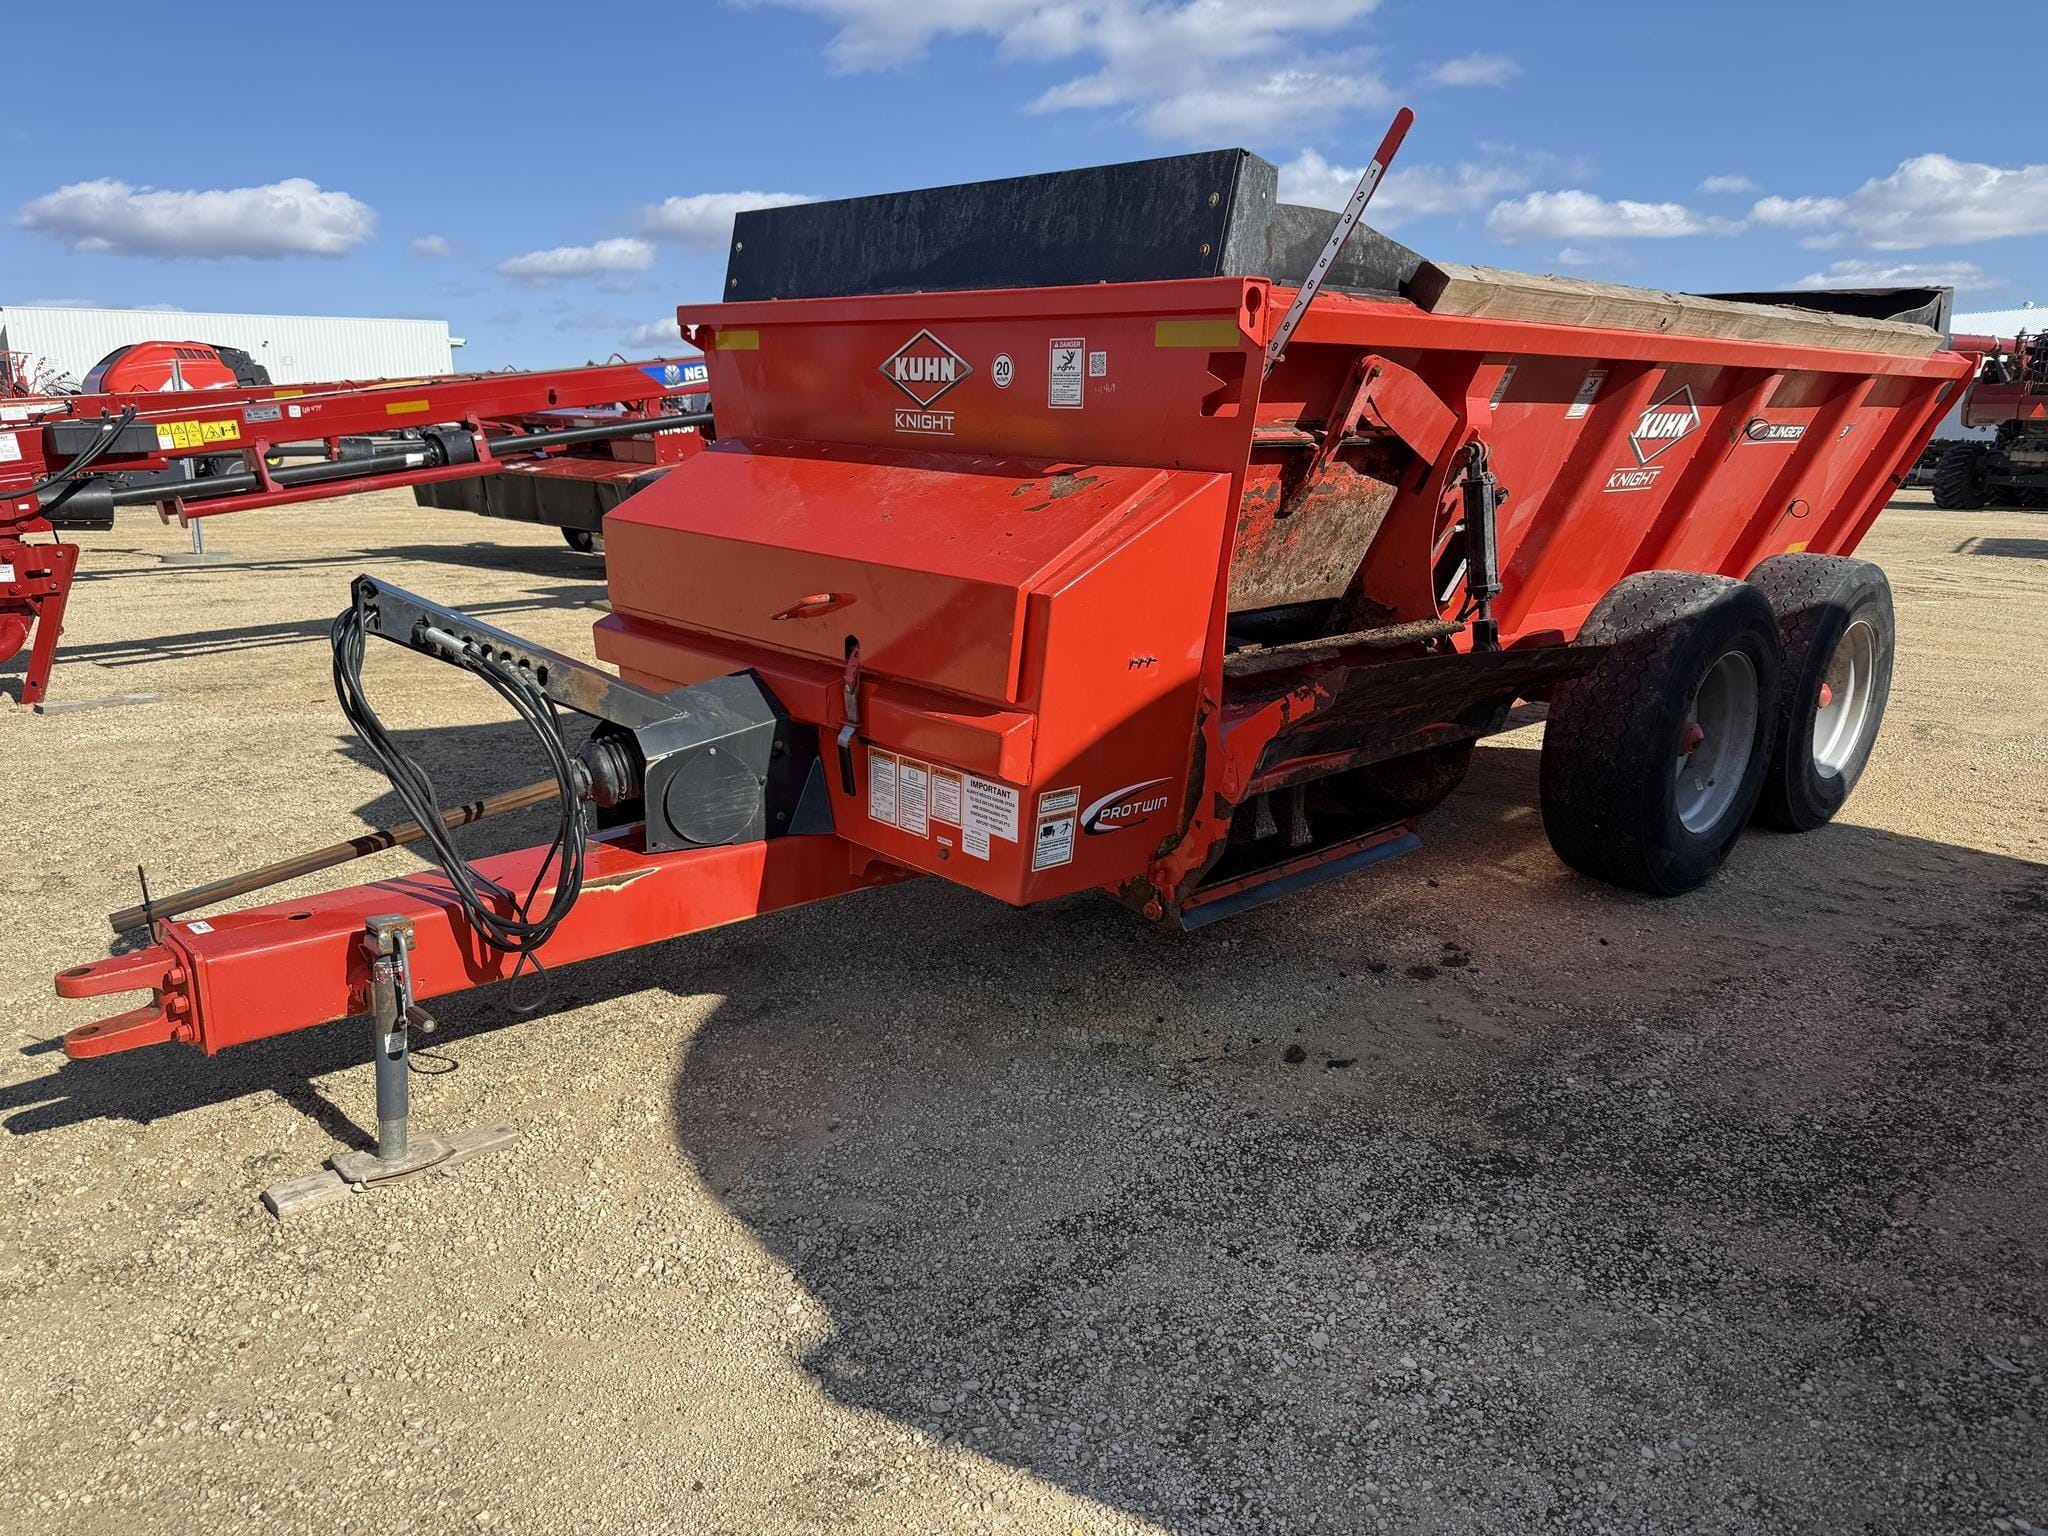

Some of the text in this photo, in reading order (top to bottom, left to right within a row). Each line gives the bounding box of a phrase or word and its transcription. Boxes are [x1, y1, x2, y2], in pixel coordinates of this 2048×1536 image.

[1370, 169, 1377, 178] 1
[1356, 191, 1365, 201] 2
[1344, 213, 1352, 224] 3
[1332, 237, 1340, 246] 4
[1319, 258, 1327, 268] 5
[1306, 280, 1315, 289] 6
[1295, 300, 1303, 310] 7
[1283, 321, 1291, 331] 8
[1271, 342, 1279, 351] 9
[684, 365, 709, 381] NE
[895, 357, 956, 382] KUHN
[996, 361, 1010, 376] 20
[895, 413, 955, 431] KNIGHT
[1634, 413, 1694, 438] KUHN
[1606, 471, 1661, 487] KNIGHT
[970, 779, 1011, 799] IMPORTANT
[1100, 797, 1167, 821] PROTWIN
